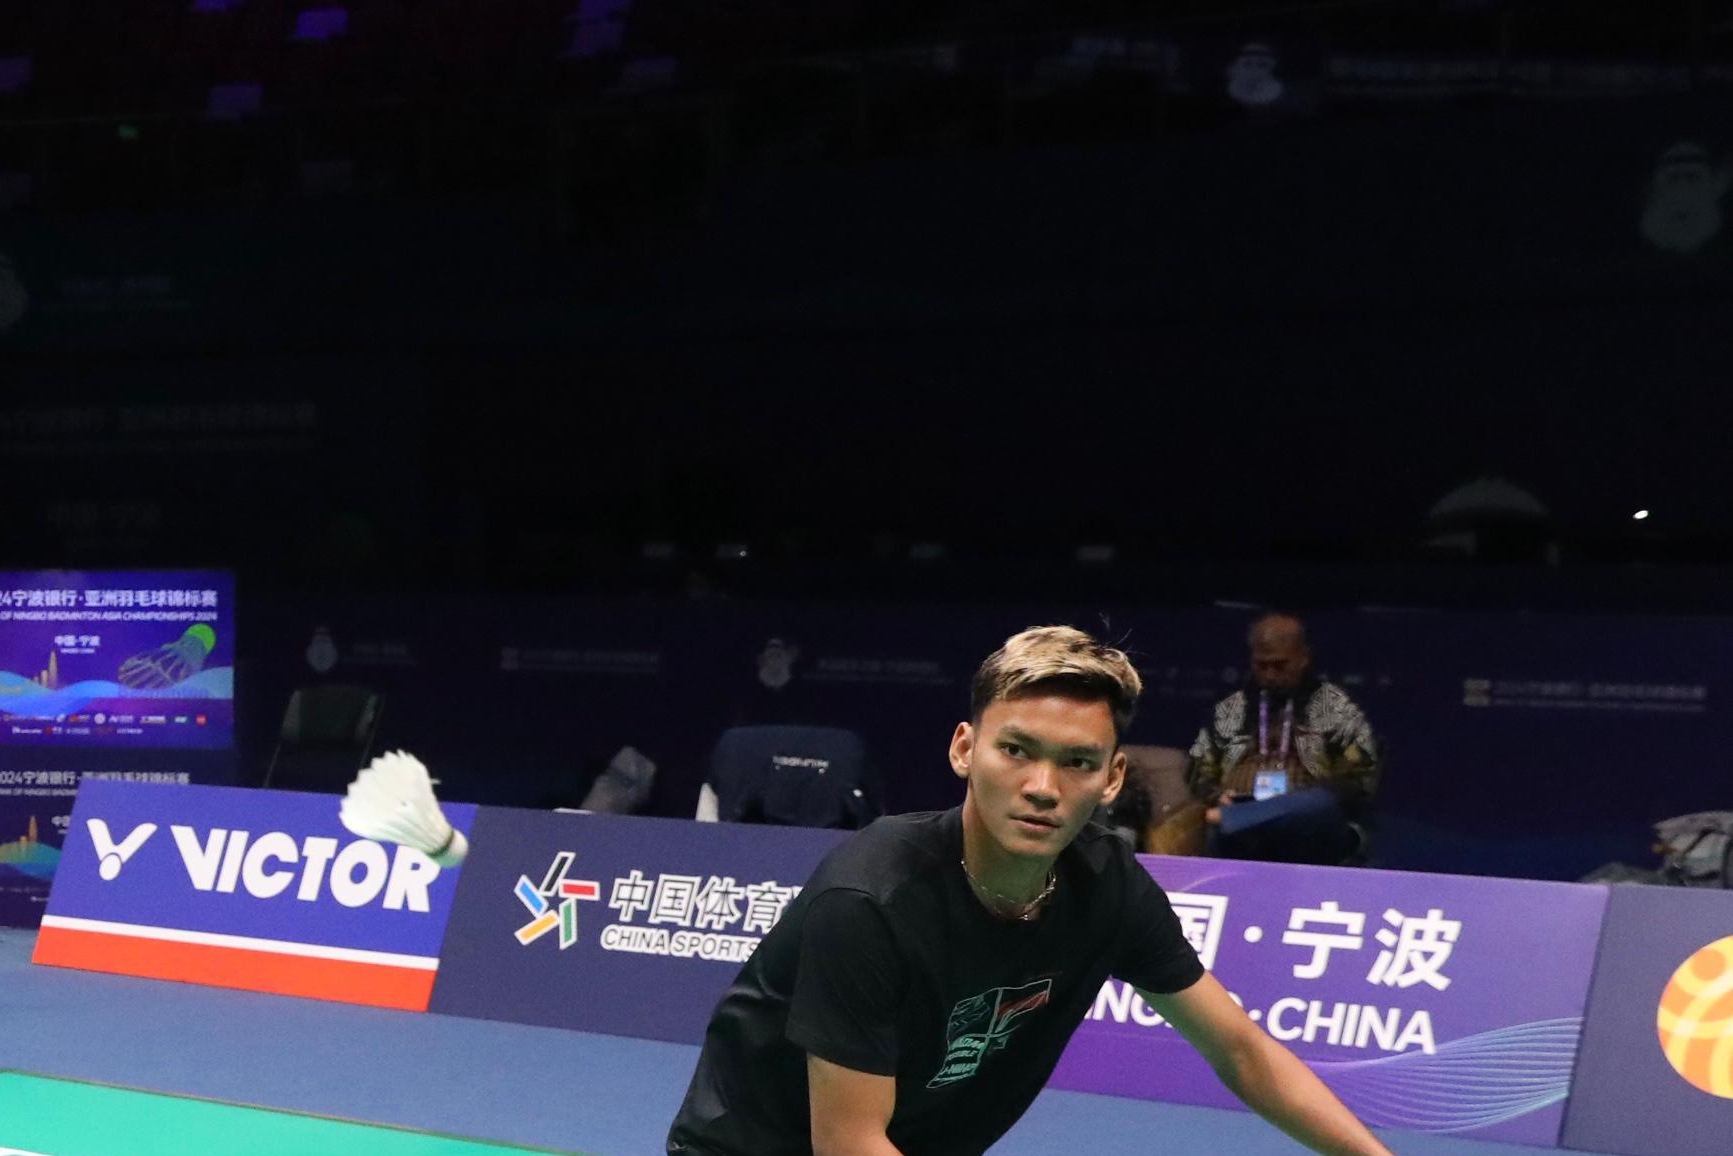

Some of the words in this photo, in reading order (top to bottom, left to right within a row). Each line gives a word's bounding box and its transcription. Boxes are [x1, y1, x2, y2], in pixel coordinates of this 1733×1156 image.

[170, 824, 442, 913] VICTOR
[608, 869, 804, 934] 中国体育
[601, 924, 668, 956] CHINA
